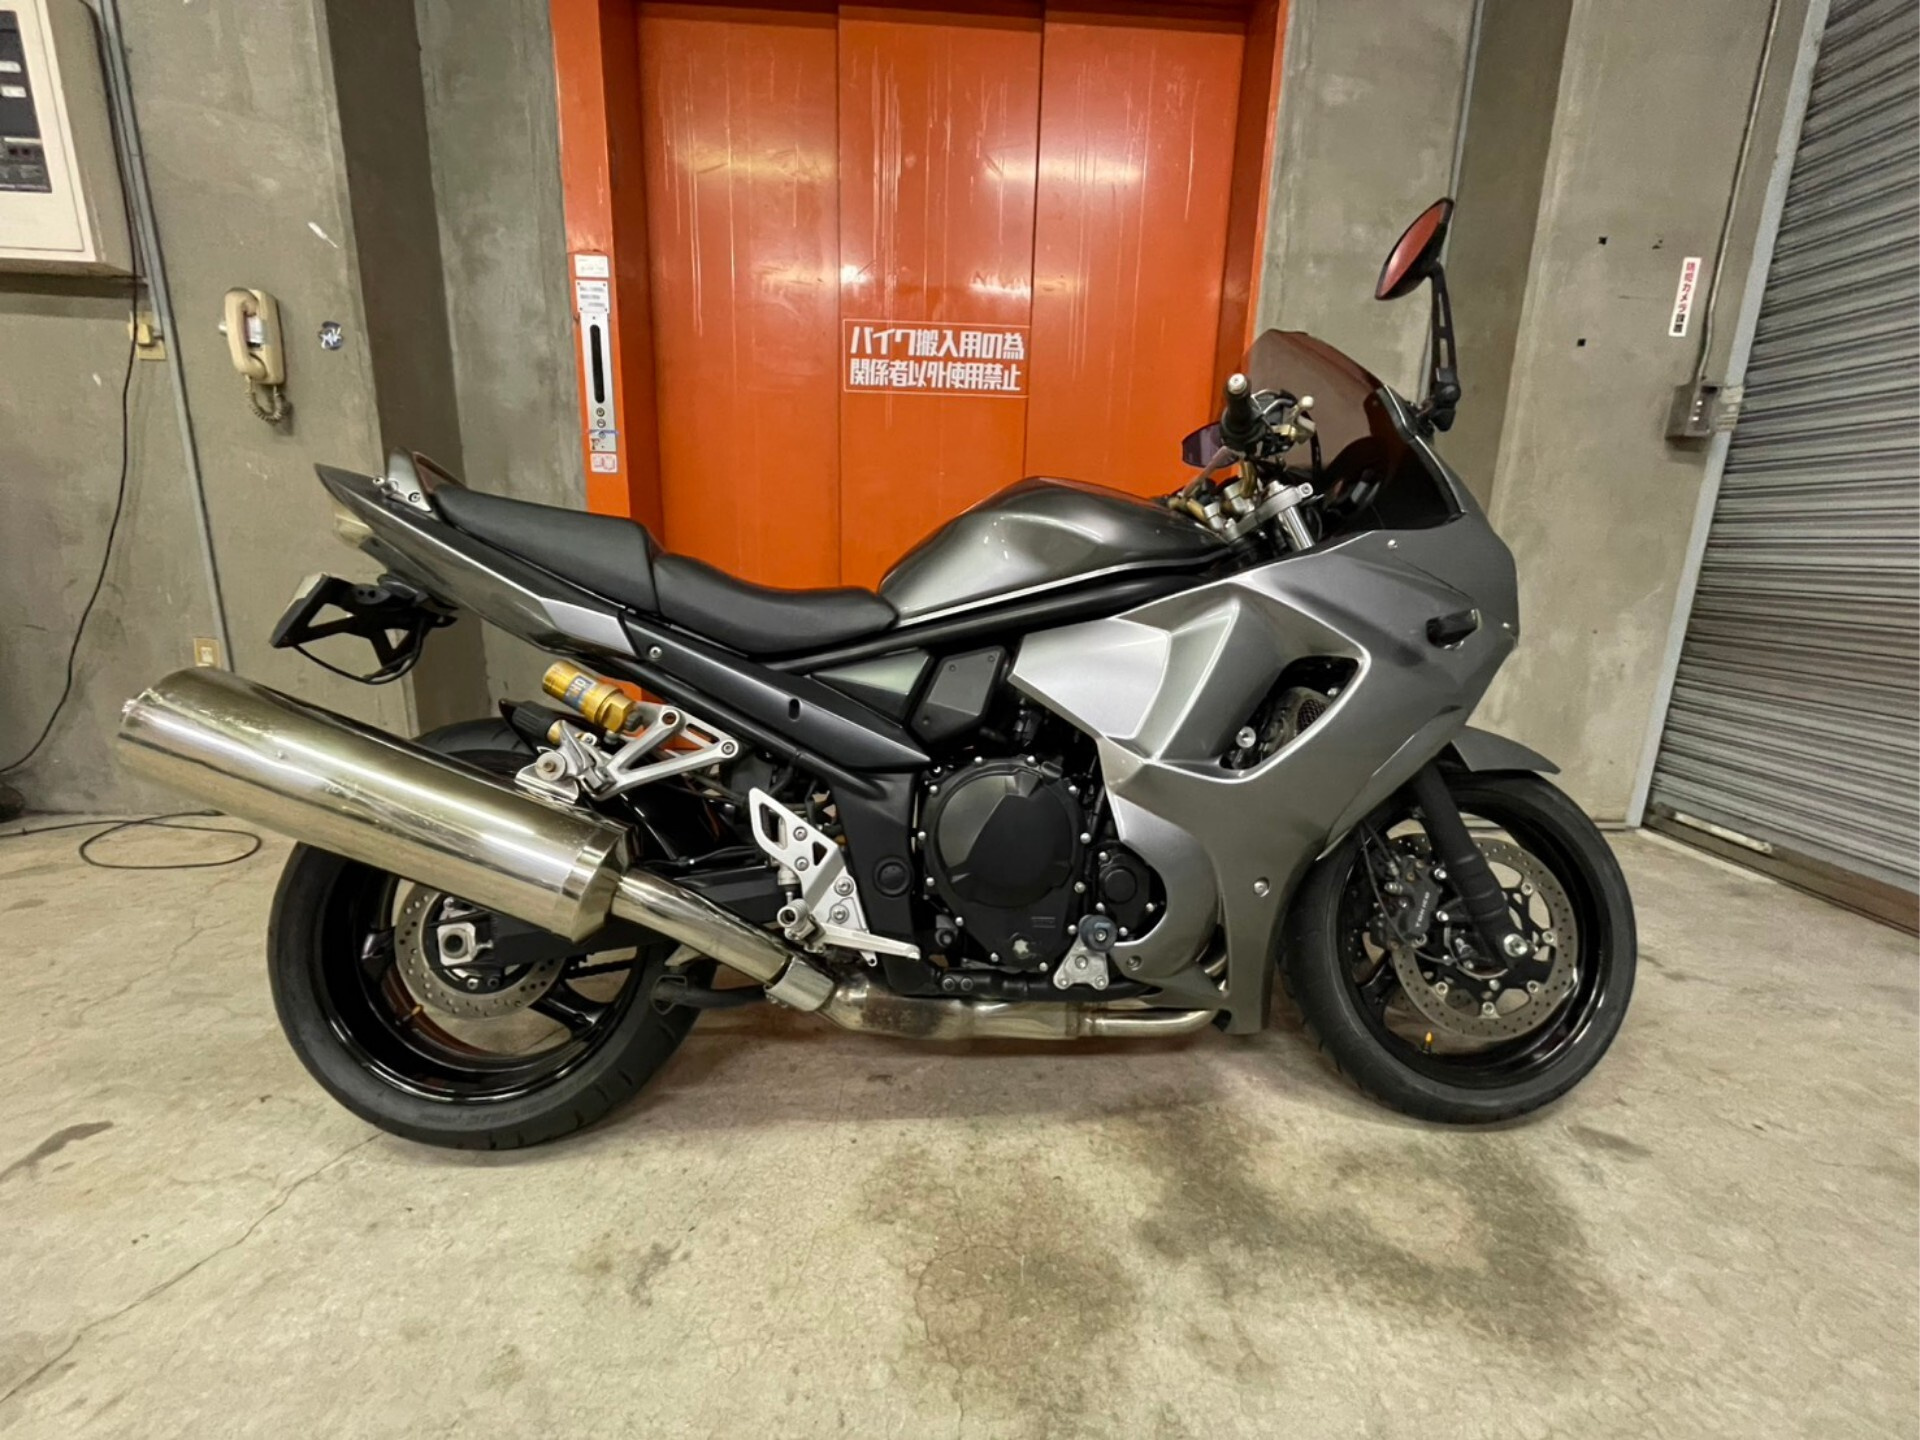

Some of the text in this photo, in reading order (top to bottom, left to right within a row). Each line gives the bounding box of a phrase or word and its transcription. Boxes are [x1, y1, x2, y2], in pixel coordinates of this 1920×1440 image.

[850, 326, 1025, 360] バイク搬入用の為
[850, 359, 1021, 391] 関係者以外使用禁止
